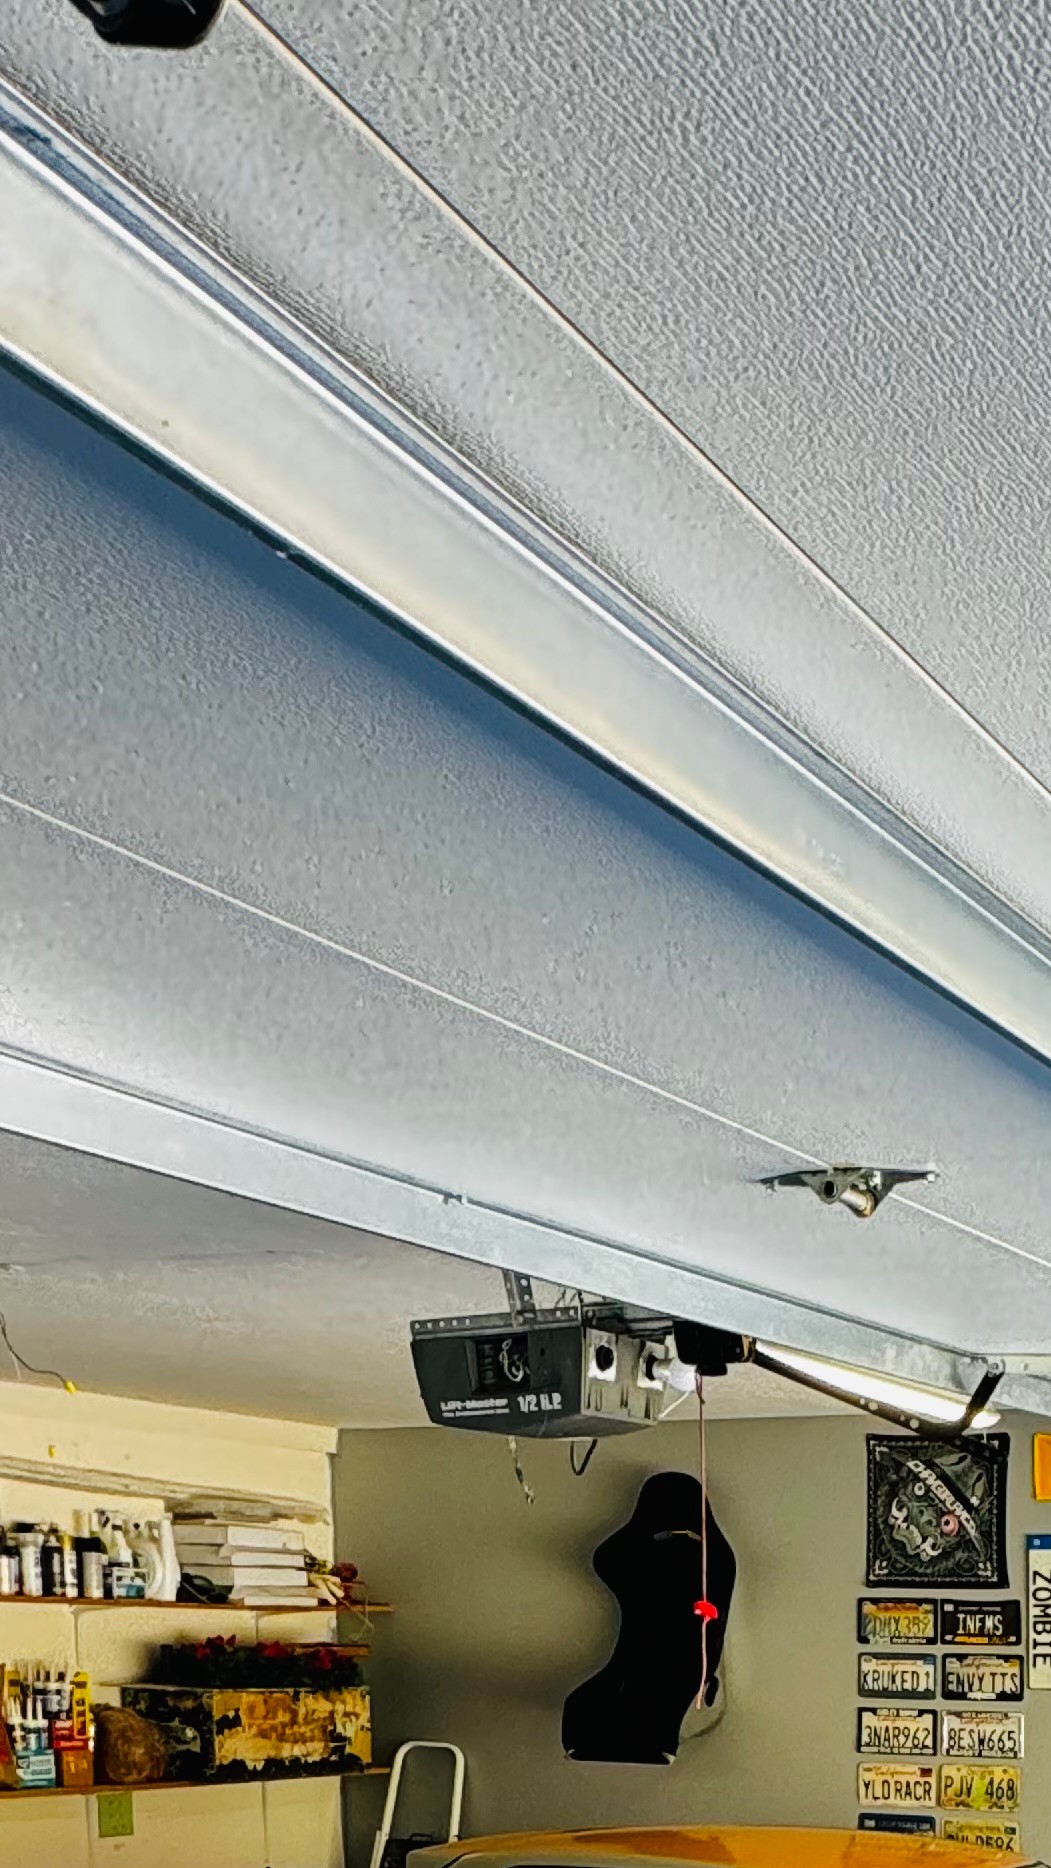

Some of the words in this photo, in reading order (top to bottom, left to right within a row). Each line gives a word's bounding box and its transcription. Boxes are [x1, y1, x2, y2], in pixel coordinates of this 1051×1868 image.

[864, 1725, 931, 1748] 3NAR962
[944, 1775, 974, 1799] PJV
[985, 1777, 1015, 1802] 468
